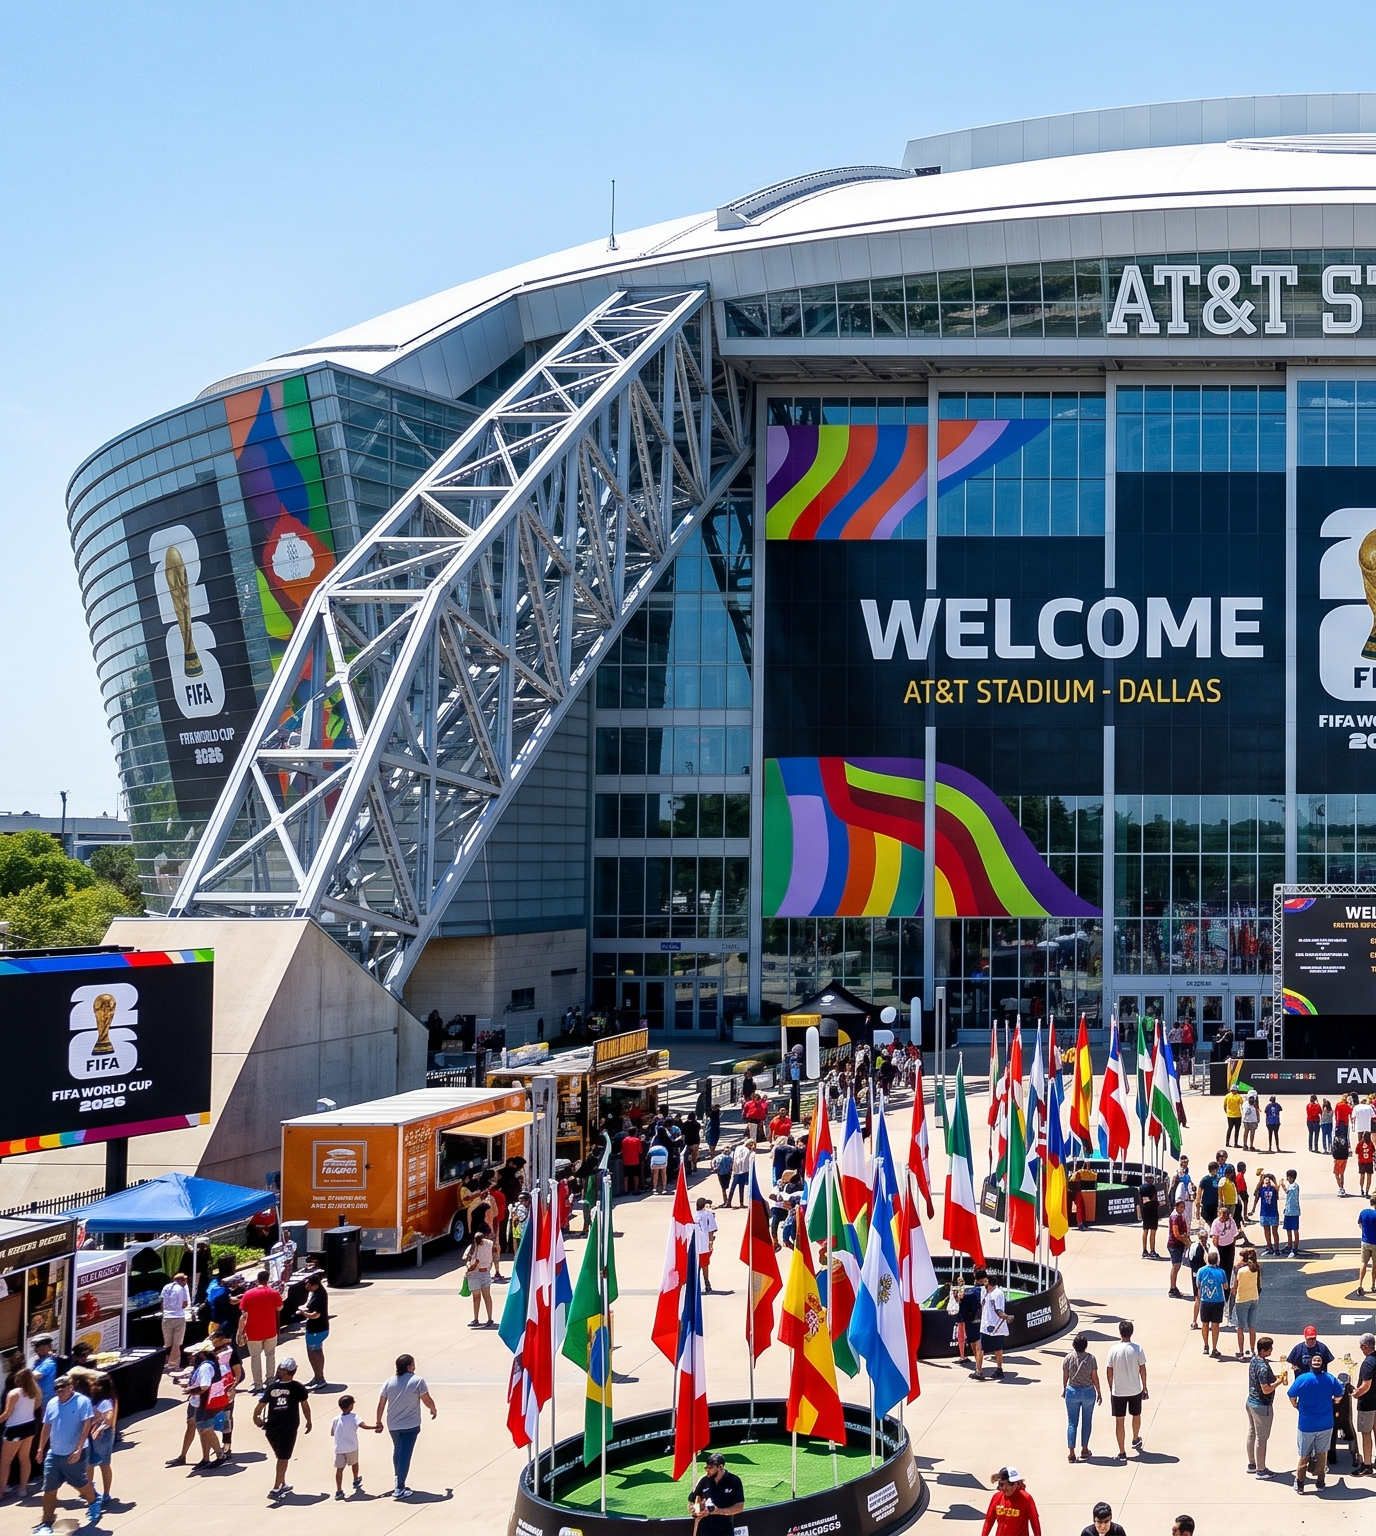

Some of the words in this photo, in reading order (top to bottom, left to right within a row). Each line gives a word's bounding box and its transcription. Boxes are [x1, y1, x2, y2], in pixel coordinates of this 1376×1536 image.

[1106, 264, 1299, 335] AT&T
[860, 596, 1264, 660] WELCOME
[184, 682, 214, 707] FIFA
[903, 679, 969, 704] AT&T
[976, 679, 1095, 704] STADIUM
[1119, 678, 1222, 704] DALLAS
[1318, 715, 1355, 728] FIFA
[86, 1057, 120, 1072] FIFA
[1336, 1067, 1376, 1084] FAN
[52, 1088, 80, 1102] FIFA
[80, 1083, 127, 1098] WORLD
[128, 1079, 153, 1092] CUP
[79, 1095, 127, 1113] 2026
